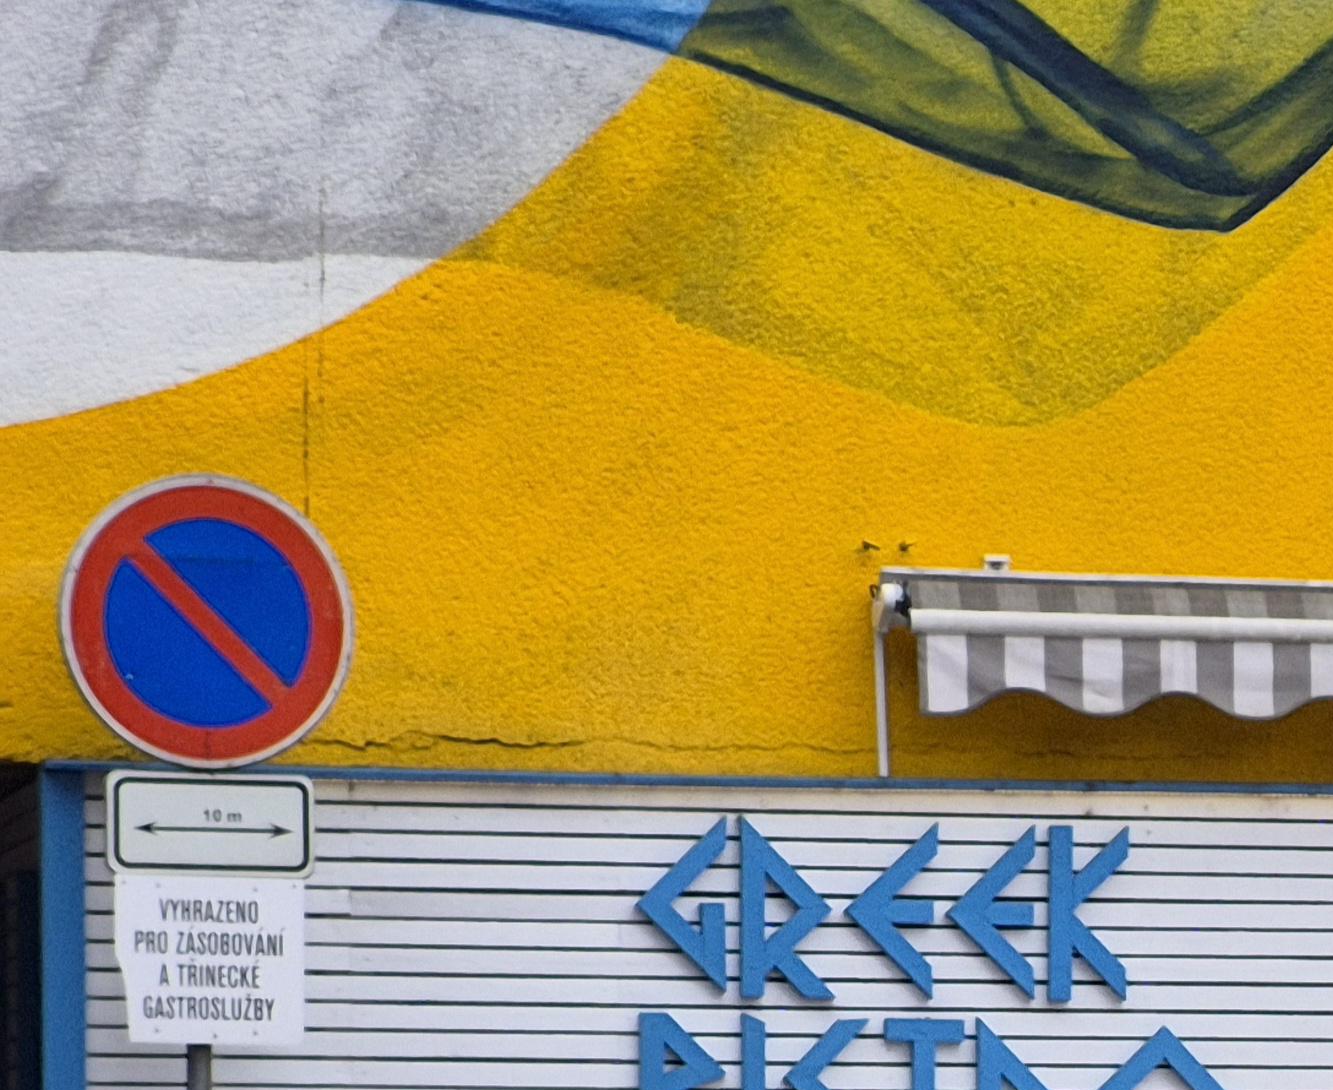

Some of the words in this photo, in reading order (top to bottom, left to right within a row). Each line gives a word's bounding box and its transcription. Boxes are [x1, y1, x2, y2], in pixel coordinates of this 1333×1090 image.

[203, 809, 221, 822] 10
[227, 812, 242, 822] m
[159, 899, 259, 924] VYHRAZENO
[635, 814, 1130, 1002] GREEK
[134, 930, 168, 954] PRO
[176, 926, 285, 956] ZÁSOBOVÁNÍ
[159, 963, 170, 986] A
[178, 957, 261, 988] TŘINECKÉ
[142, 993, 275, 1021] GASTROSLUŽBY
